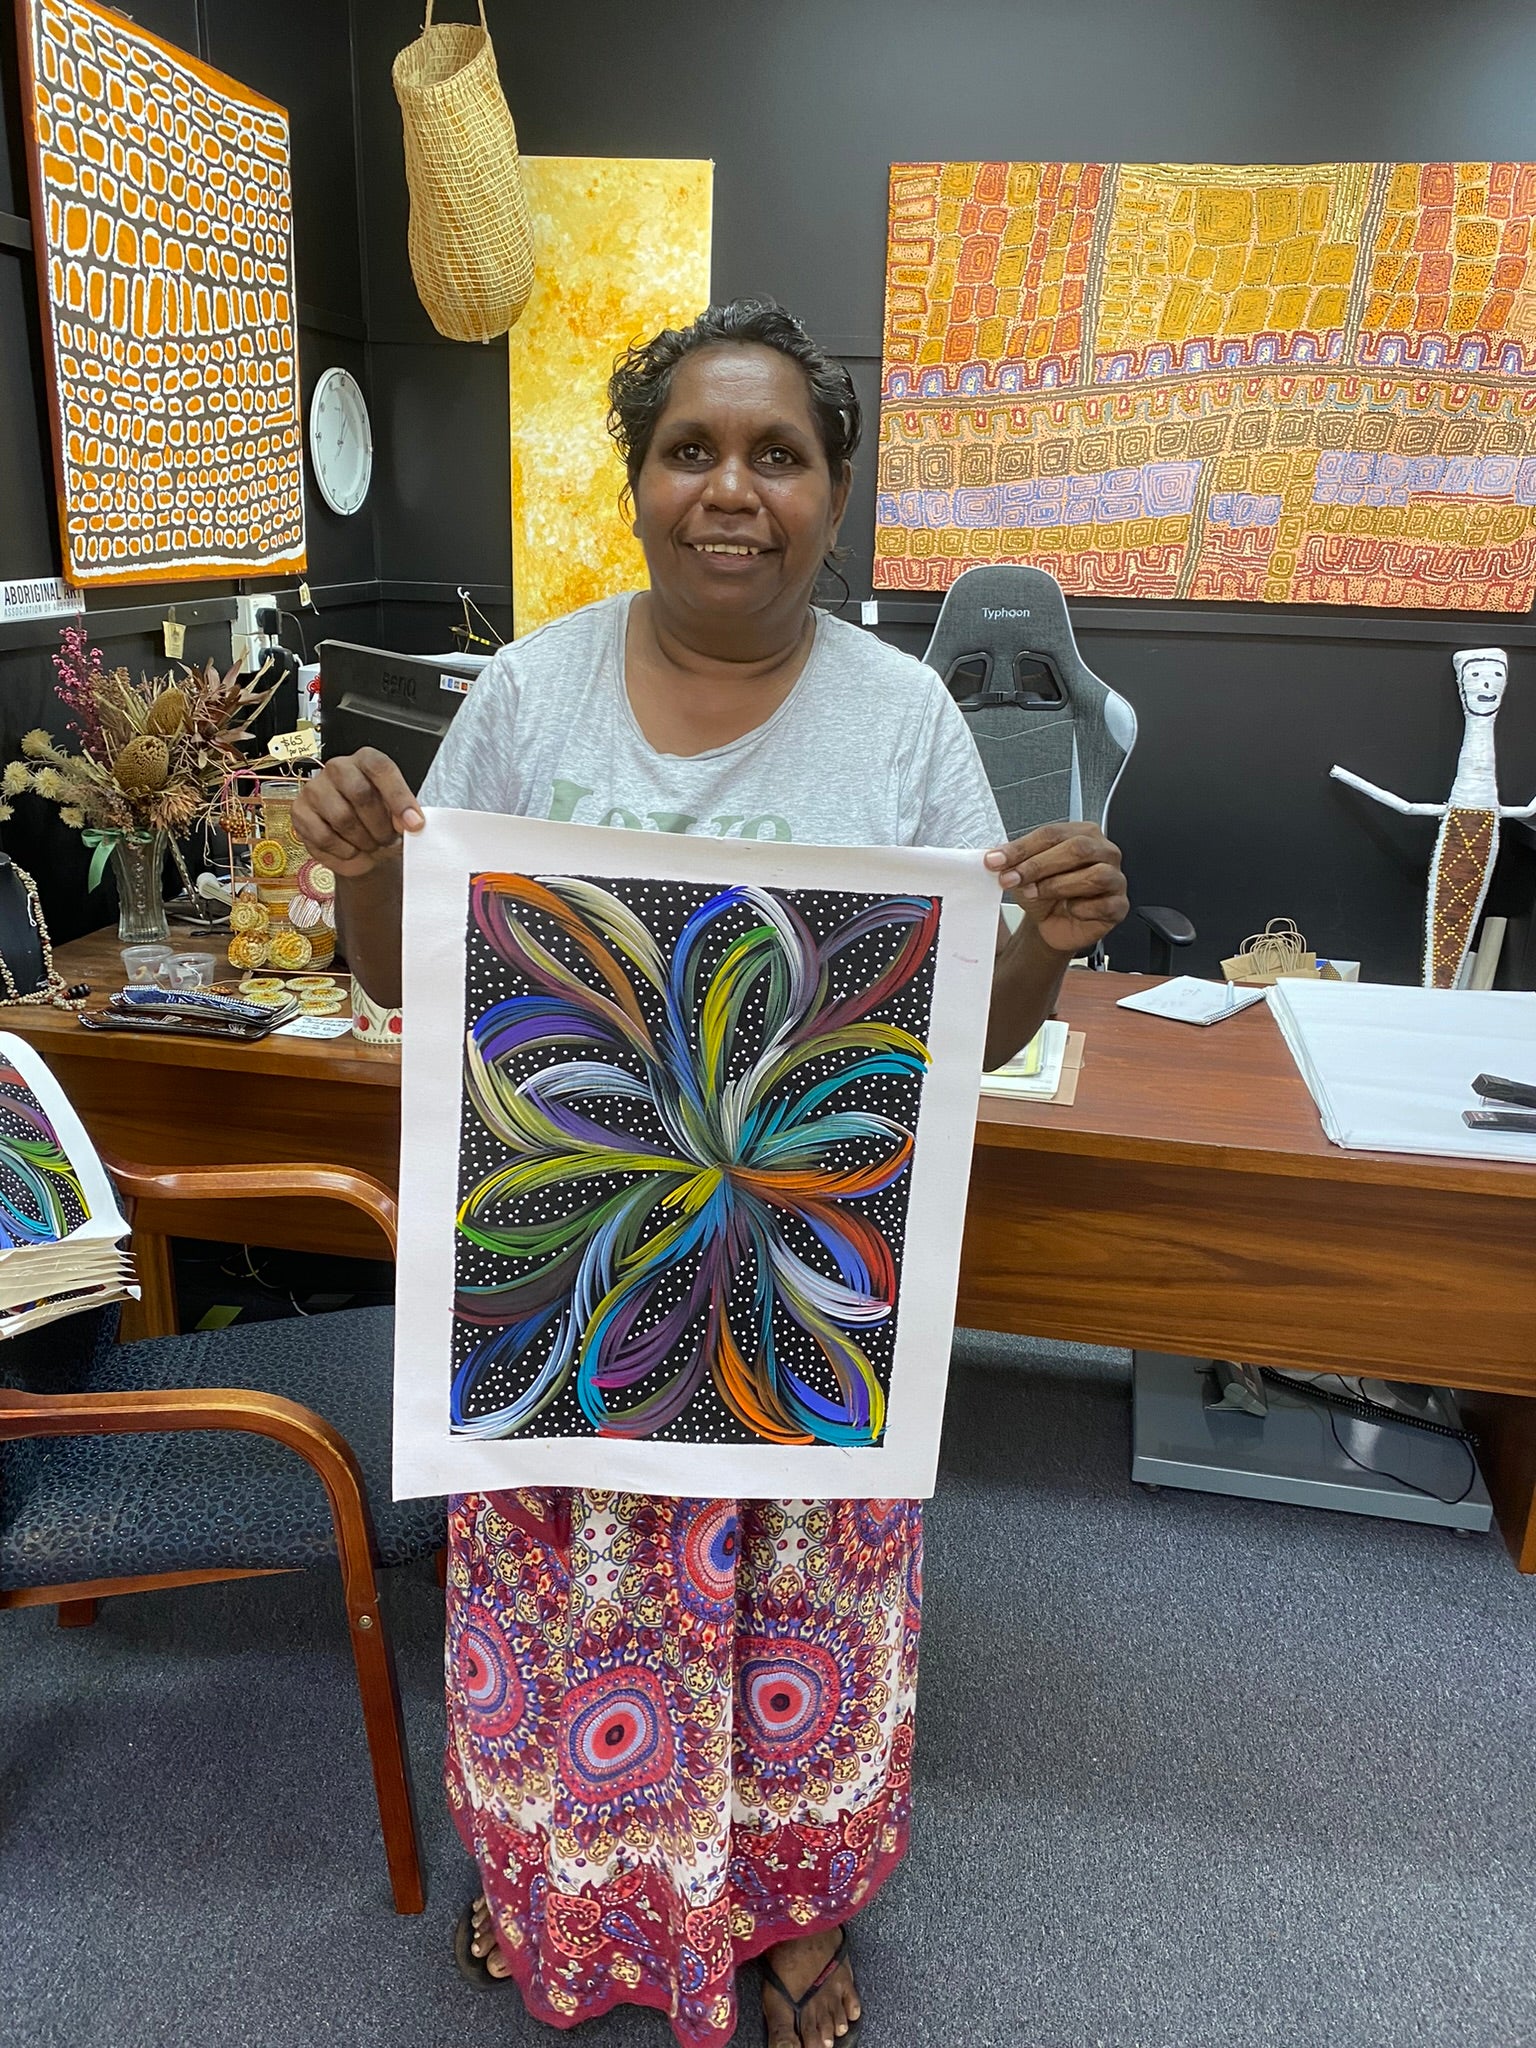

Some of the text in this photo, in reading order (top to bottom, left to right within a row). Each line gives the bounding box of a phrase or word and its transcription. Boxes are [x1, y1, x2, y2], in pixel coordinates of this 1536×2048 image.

[4, 582, 62, 606] ABORIGINAL
[4, 604, 42, 617] ASSOCIATION
[44, 602, 51, 613] OF
[981, 607, 1030, 620] Typhoon
[280, 734, 303, 752] $65
